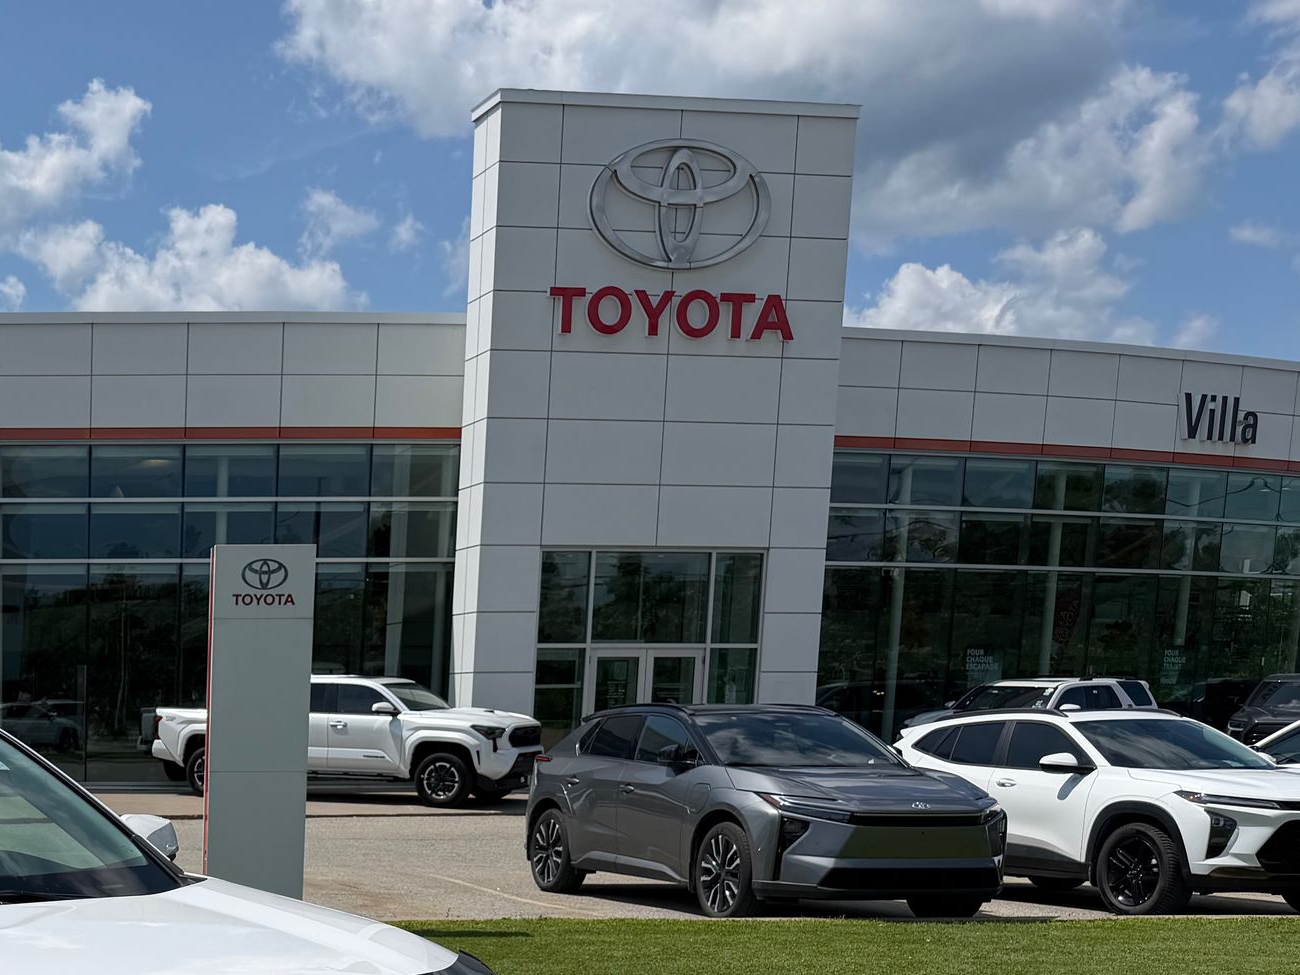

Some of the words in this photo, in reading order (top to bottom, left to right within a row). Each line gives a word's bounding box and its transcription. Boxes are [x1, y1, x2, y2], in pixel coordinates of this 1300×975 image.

[549, 285, 794, 340] TOYOTA
[1184, 392, 1258, 444] Villa
[232, 593, 296, 606] TOYOTA
